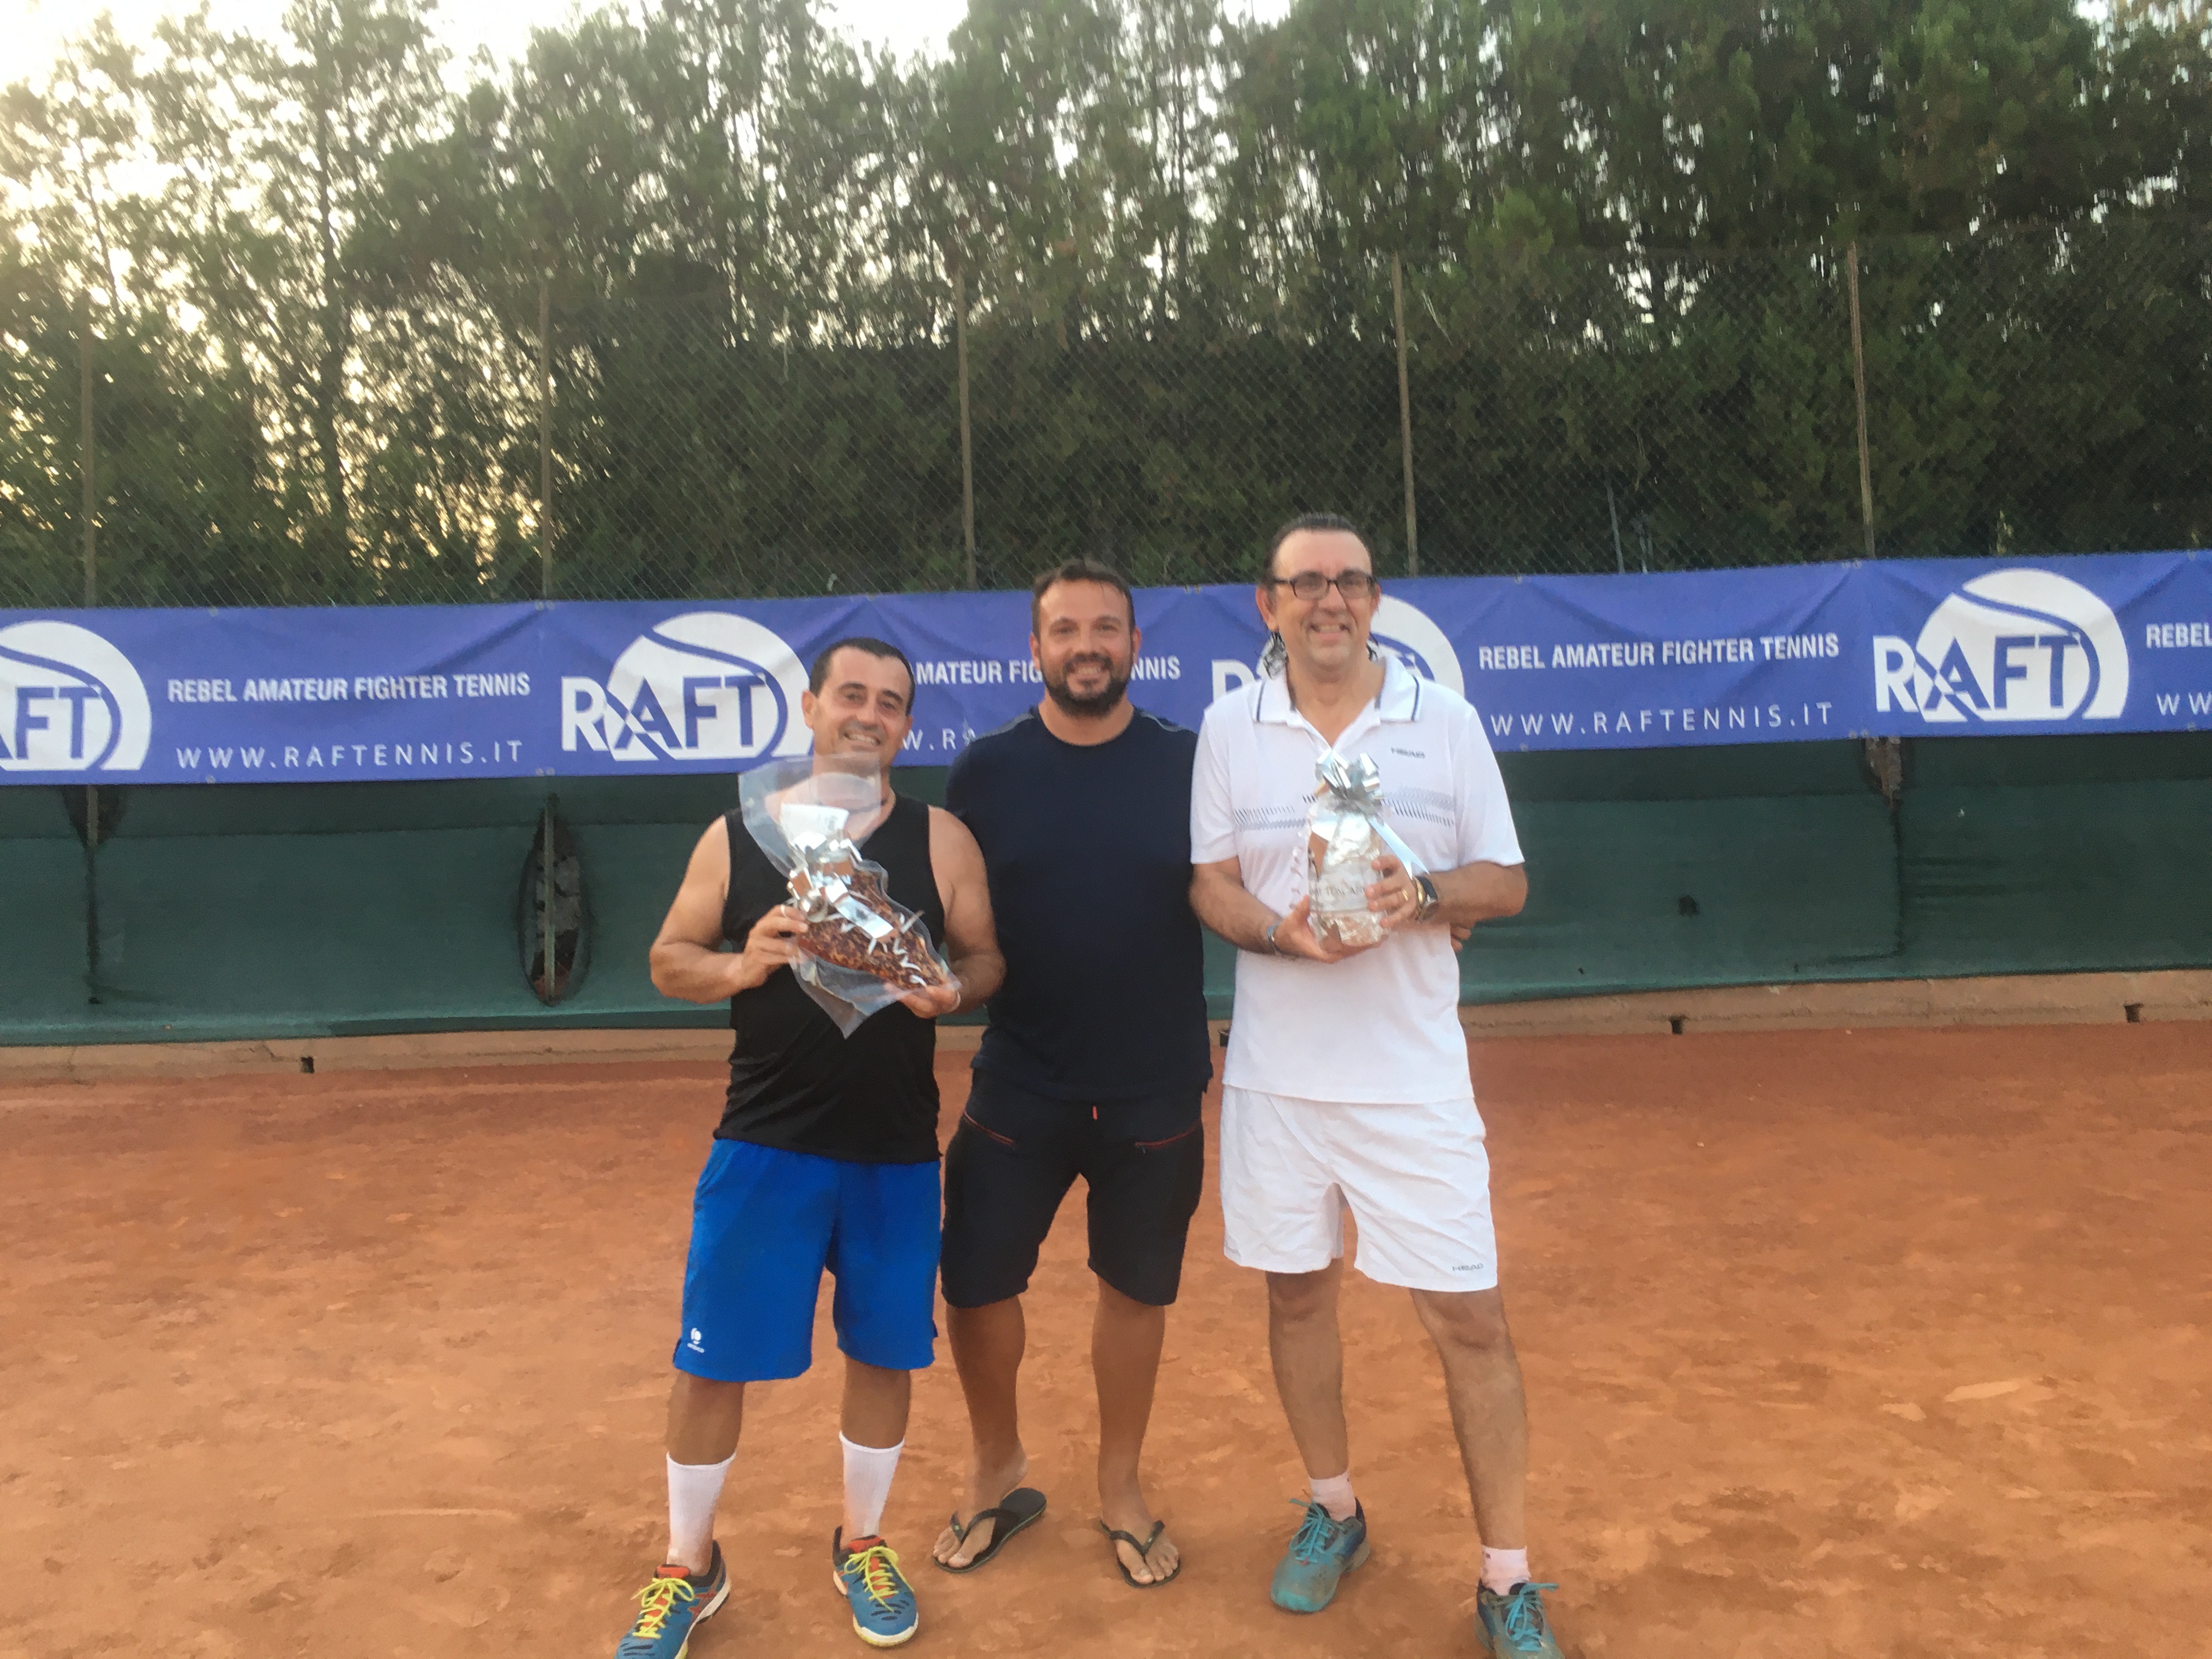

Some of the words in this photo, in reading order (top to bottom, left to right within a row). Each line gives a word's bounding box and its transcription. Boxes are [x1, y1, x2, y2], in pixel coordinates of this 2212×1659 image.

[1479, 645, 1546, 670] REBEL
[1551, 641, 1655, 668] AMATEUR
[1662, 637, 1755, 665] FIGHTER
[1759, 632, 1839, 661] TENNIS
[167, 679, 238, 703] REBEL
[242, 677, 348, 702] AMATEUR
[354, 675, 448, 700] FIGHTER
[453, 671, 531, 697] TENNIS
[909, 659, 1003, 685] MATEUR
[1873, 633, 2081, 713] RAFT
[561, 675, 766, 751] RAFT
[1490, 701, 1832, 736] WWW.RAFTENNIS.IT
[175, 740, 523, 769] WWW.RAFTENNIS.IT
